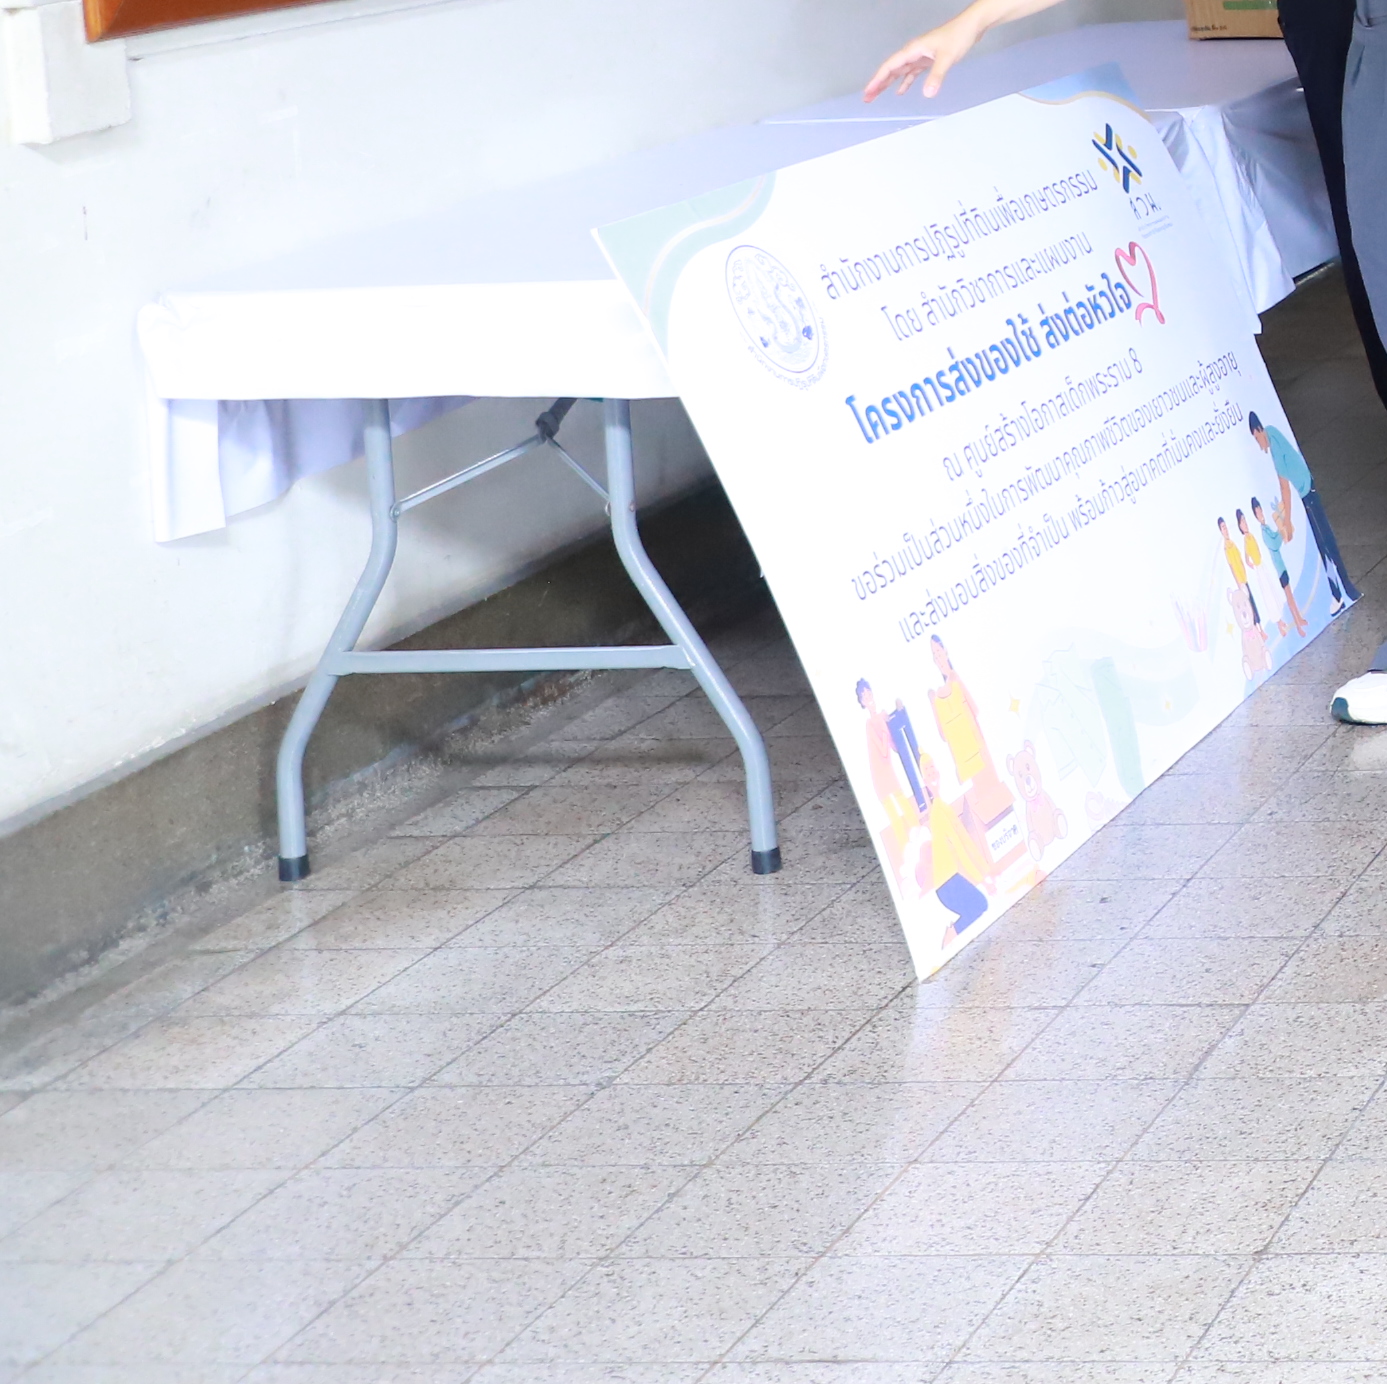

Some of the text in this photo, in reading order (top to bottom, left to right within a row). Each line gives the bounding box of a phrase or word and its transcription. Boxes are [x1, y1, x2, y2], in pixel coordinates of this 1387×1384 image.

[819, 170, 1098, 300] สำนักงานการปฏิรูปที่ดินเพื่อเกษตรกรรม
[881, 232, 1093, 341] โดย สำนักวิชาการและแผนงาน
[845, 314, 1042, 444] โครงการส่งของใช้
[1037, 272, 1132, 349] ส่งต่อหัวใจ
[942, 347, 1143, 480] ณ ศูนย์สร้างโอกาสเด็กพระราม 8
[851, 351, 1242, 600] ขอร่วมเป็นส่วนหนึ่งในการพัฒนาคุณภาพชีวิตของเยาวชนและผู้สูงอายุ
[899, 400, 1244, 643] และส่งมอบสิ่งของที่จำเป็น พร้อมก้าวสู่อนาคตที่มั่นคงและยั่งยืน
